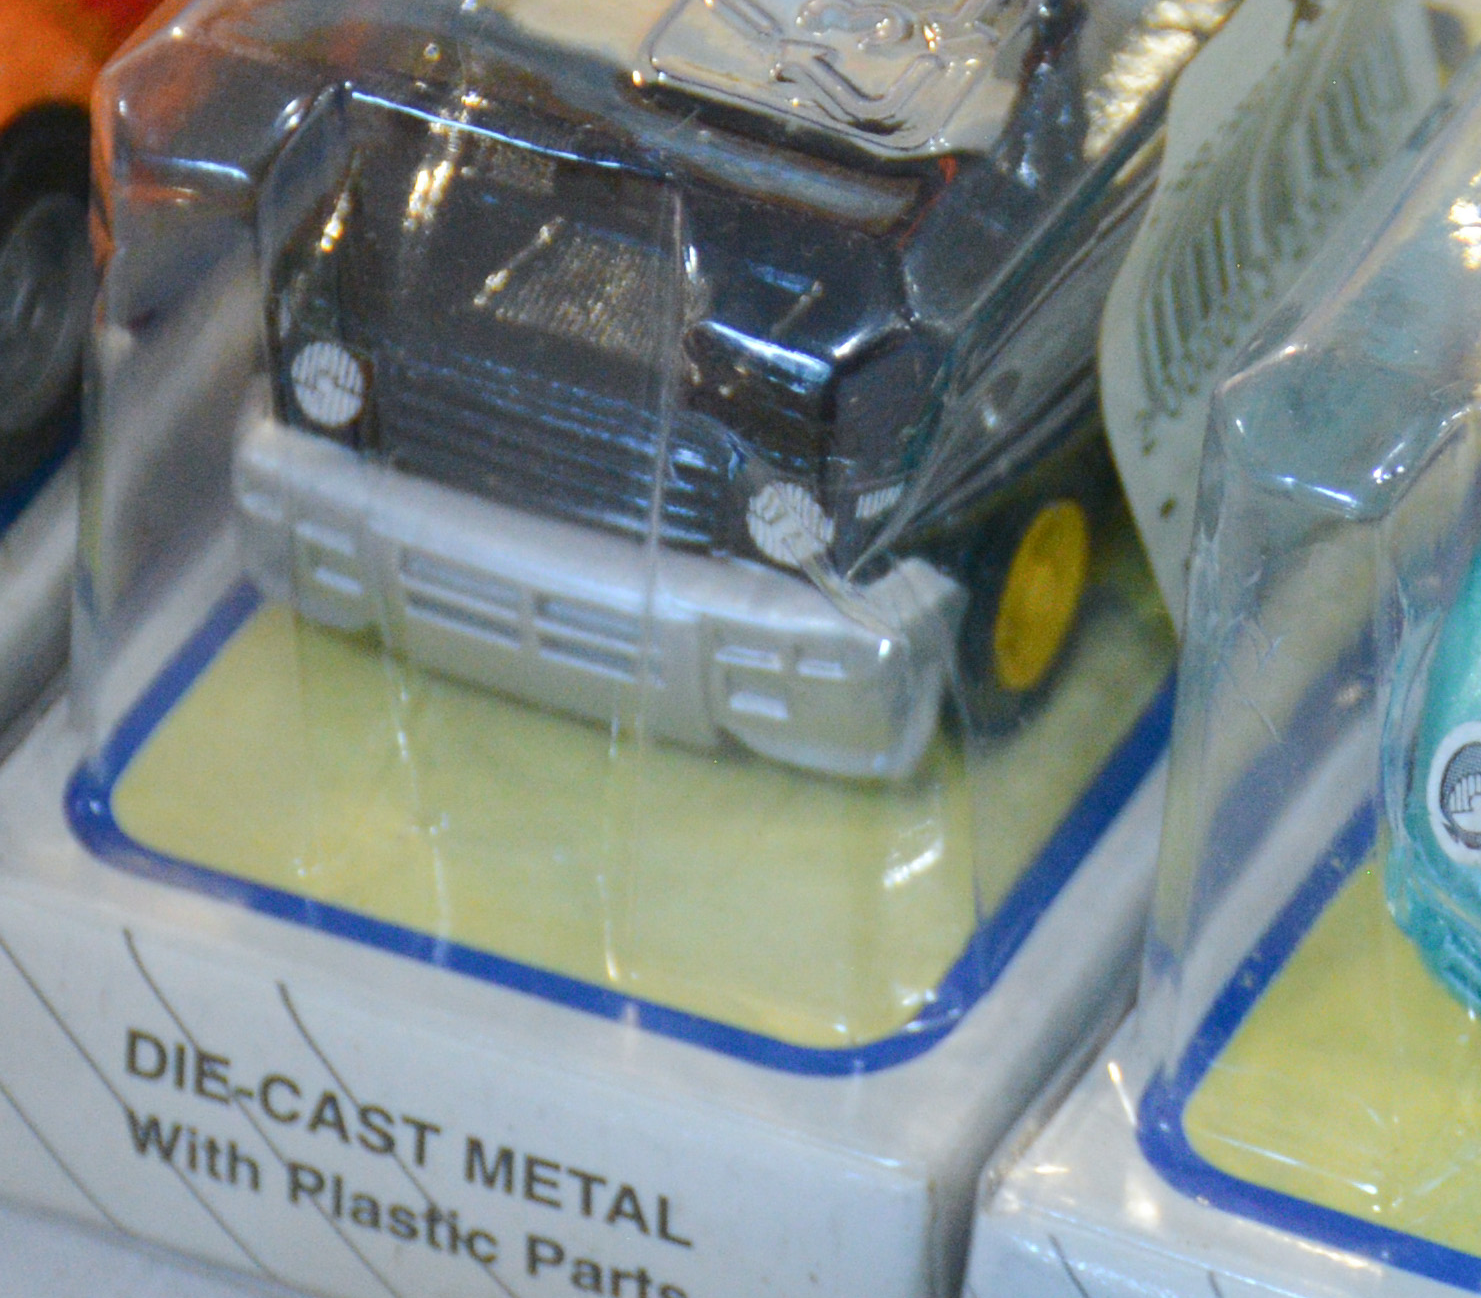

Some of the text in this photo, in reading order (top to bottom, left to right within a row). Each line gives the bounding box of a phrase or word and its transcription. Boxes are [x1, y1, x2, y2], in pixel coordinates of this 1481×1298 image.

[124, 1028, 694, 1249] DIE-CAST METAL
[126, 1107, 262, 1192] With
[287, 1160, 499, 1265] Plastic
